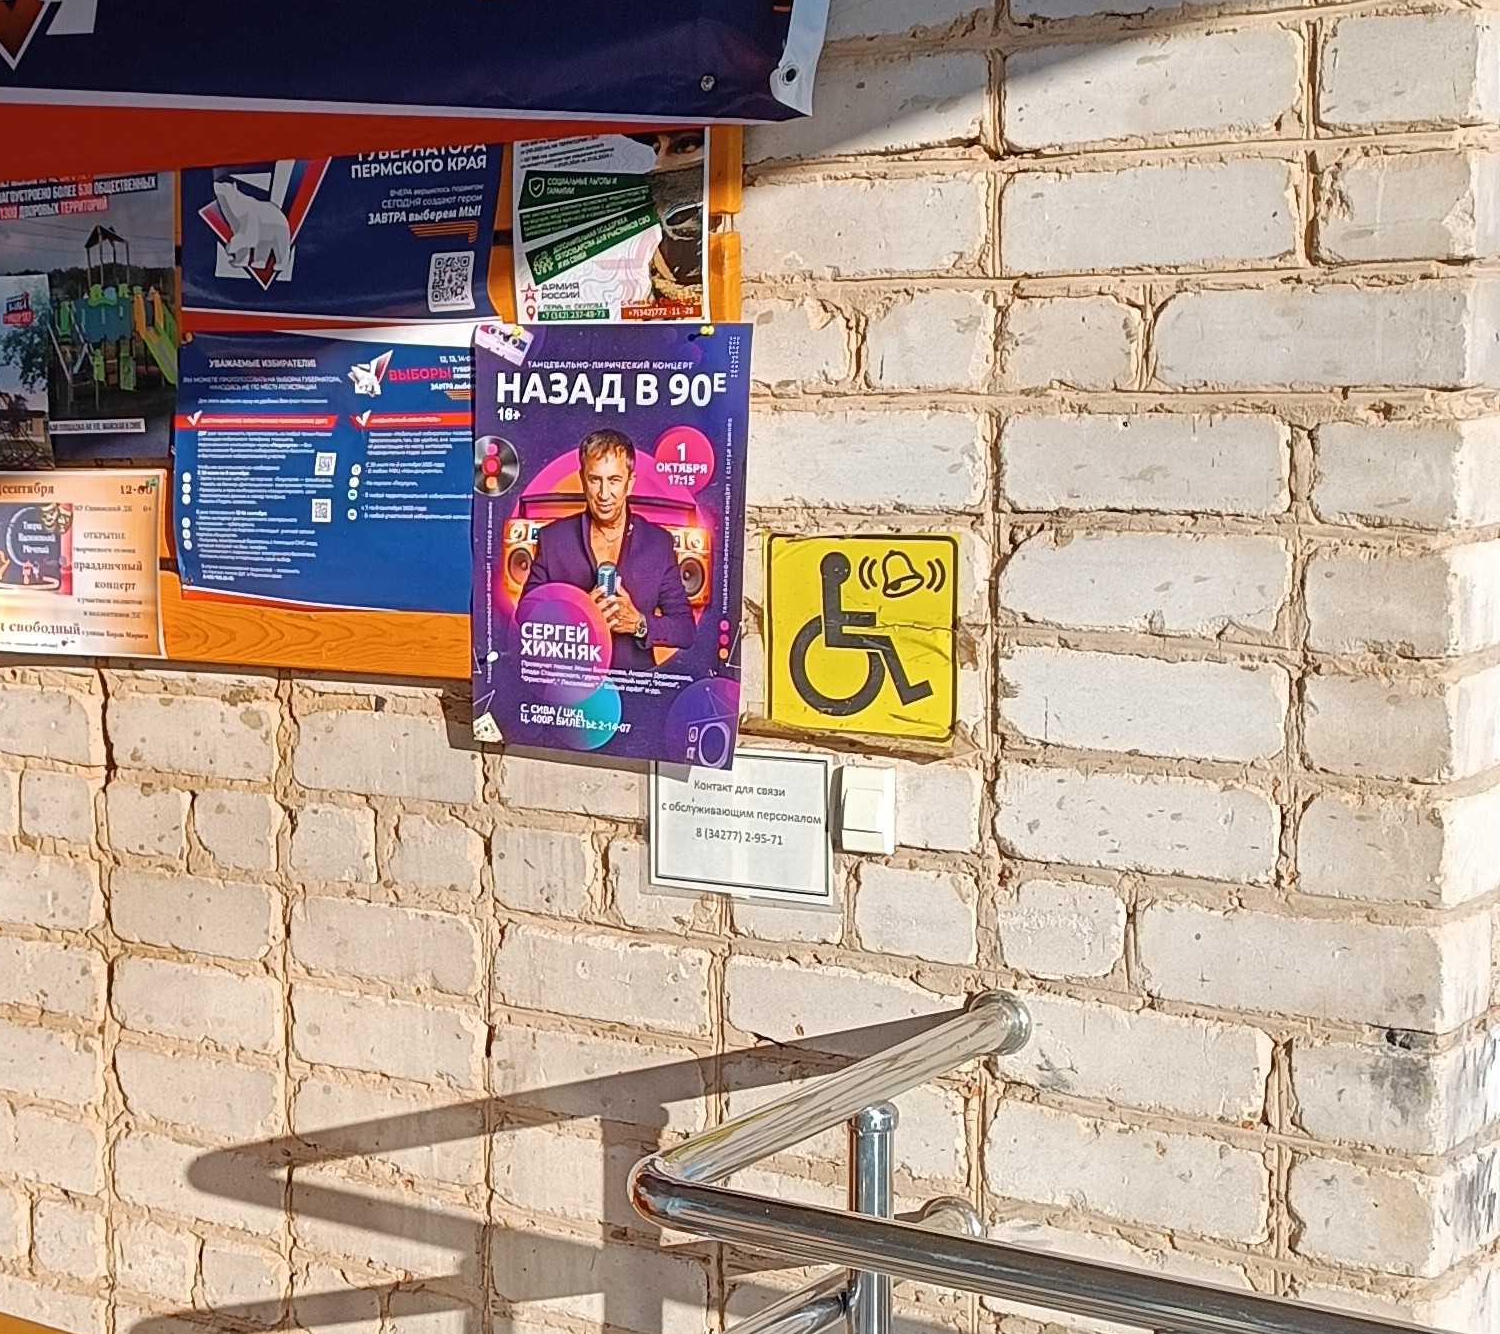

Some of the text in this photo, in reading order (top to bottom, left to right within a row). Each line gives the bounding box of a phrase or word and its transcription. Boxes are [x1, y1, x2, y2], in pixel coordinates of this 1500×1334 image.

[351, 155, 487, 178] ПЕРМСКОГО КРАЯ
[382, 198, 421, 209] СЕГОДНЯ
[368, 211, 407, 225] ЗАВТРА
[409, 208, 457, 222] выберем
[542, 282, 579, 291] АРМИЯ
[541, 291, 580, 300] РОССИИ
[209, 359, 260, 368] УВАЖАЕМЫЕ
[388, 366, 451, 382] ВЫБОРЫ
[497, 372, 626, 412] НАЗАД
[635, 373, 659, 405] В
[676, 443, 686, 461] 1
[656, 462, 707, 474] ОКТЯБРЯ
[668, 474, 695, 486] 17:15
[2, 482, 54, 497] сентября
[83, 532, 126, 540] ОТКРЫТИЕ
[73, 560, 143, 572] праздничный
[94, 581, 136, 592] концерт
[9, 622, 81, 636] свободный
[521, 621, 589, 643] СЕРГЕЙ
[521, 639, 603, 663] ХИЖНЯК
[520, 704, 529, 713] С.
[531, 705, 555, 716] СИВА
[563, 708, 583, 719] ЦКД
[599, 720, 631, 733] 2-14-07
[694, 779, 786, 797] Контакт для связи
[661, 799, 821, 825] с обслуживающим персоналом
[695, 828, 783, 845] 8 (34277) 2-95-71
